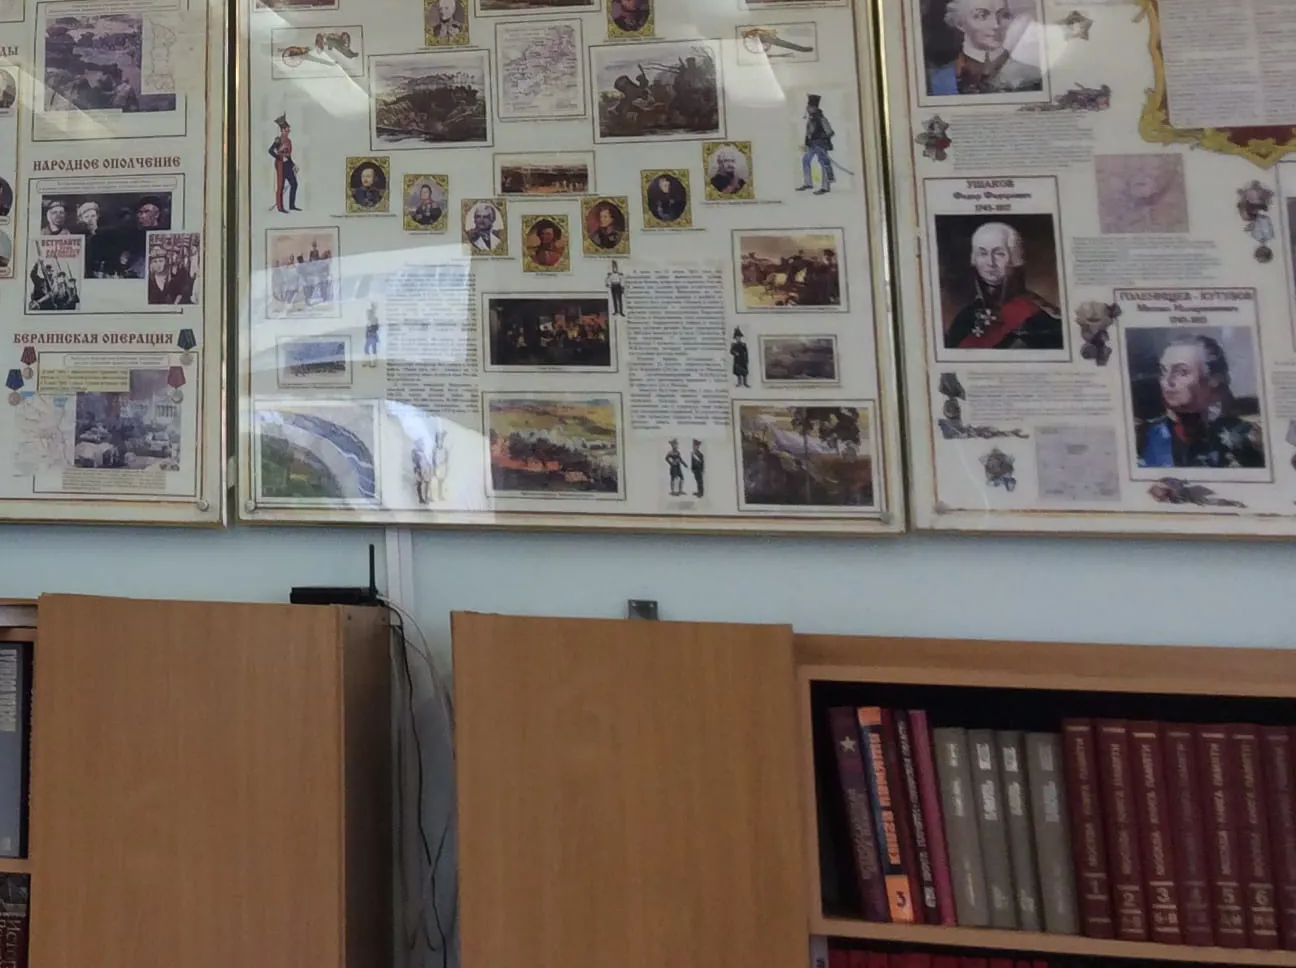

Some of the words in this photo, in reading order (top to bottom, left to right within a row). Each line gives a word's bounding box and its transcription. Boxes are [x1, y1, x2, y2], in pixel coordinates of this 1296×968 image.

[33, 159, 99, 171] НАРОДНОЕ
[103, 155, 181, 169] ОПОЛЧЕНИЕ
[13, 333, 99, 345] БЕРЛИНСКАЯ
[102, 333, 173, 346] ОПЕРАЦИЯ
[1123, 892, 1135, 907] 2
[1156, 886, 1171, 903] 3
[1223, 887, 1235, 904] 5
[1255, 889, 1268, 905] 6
